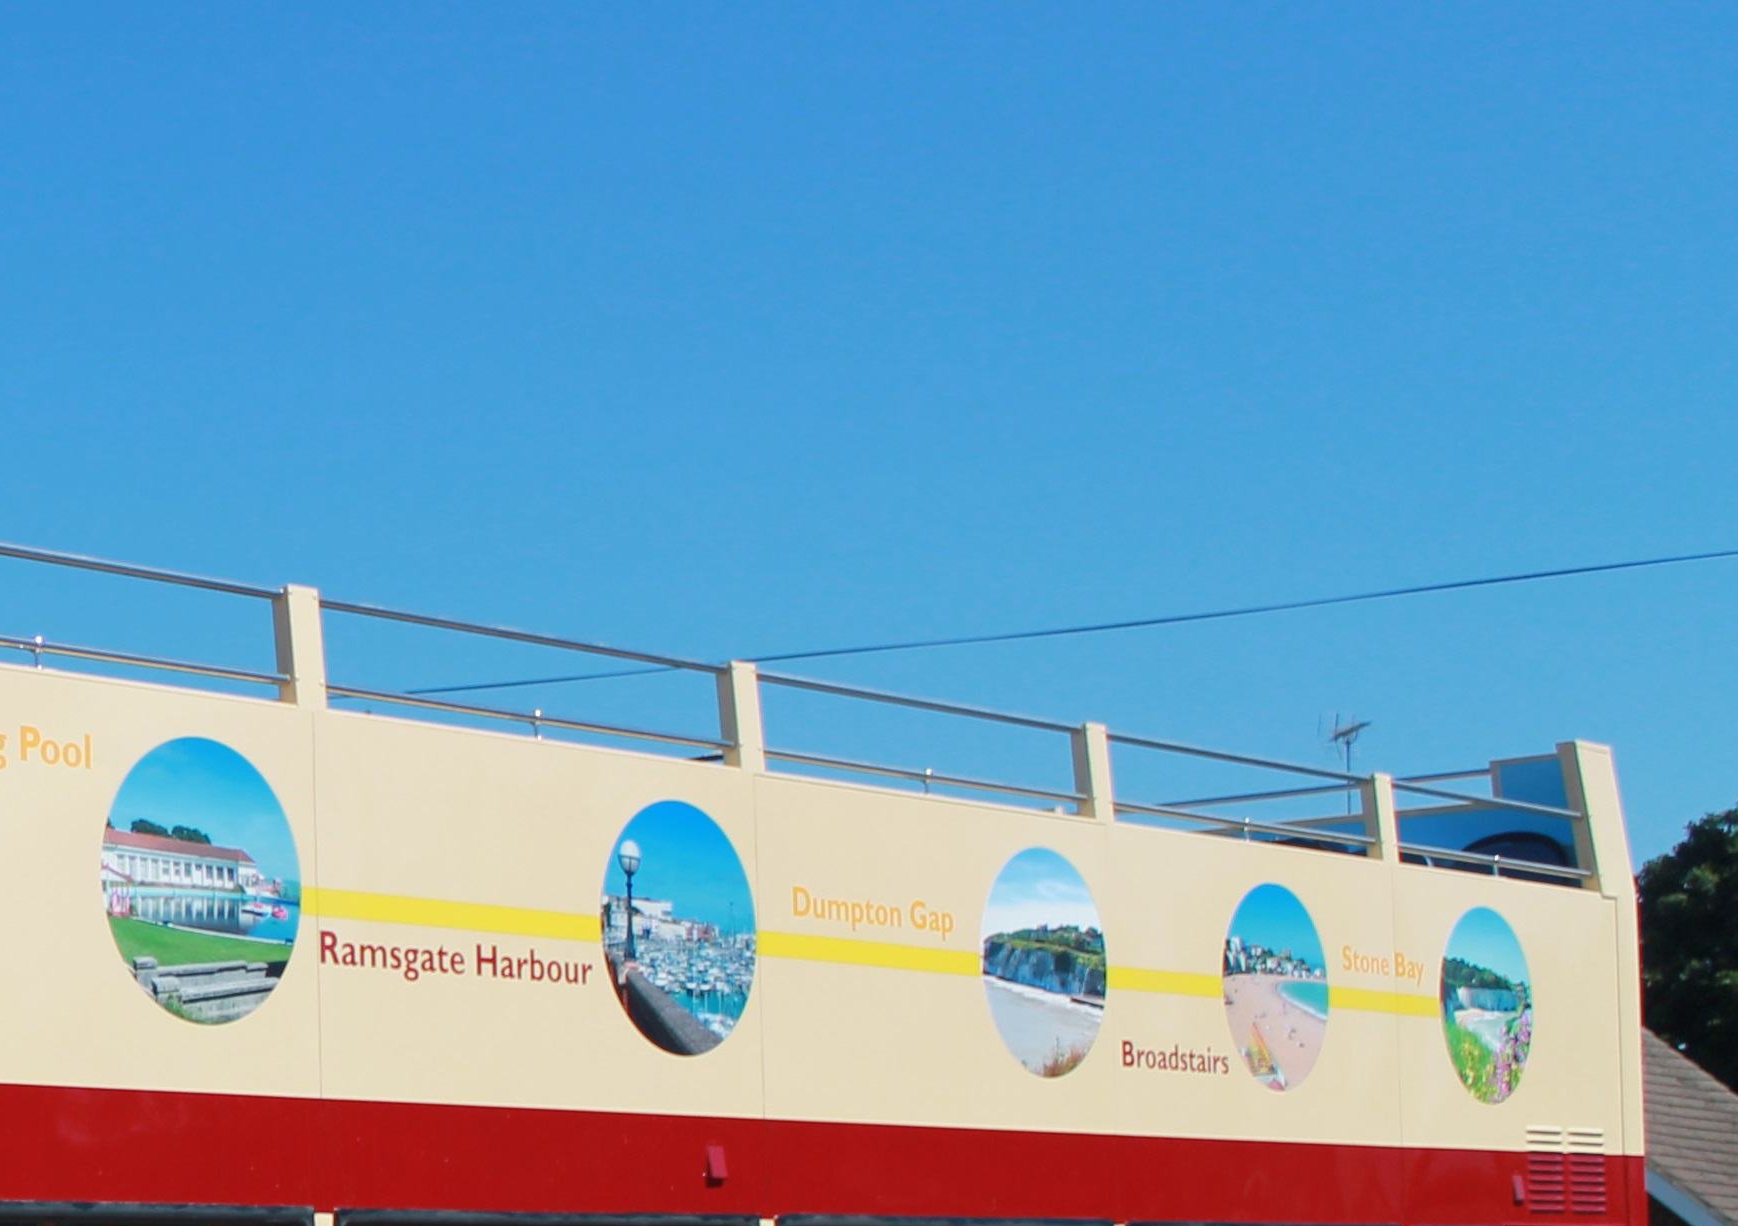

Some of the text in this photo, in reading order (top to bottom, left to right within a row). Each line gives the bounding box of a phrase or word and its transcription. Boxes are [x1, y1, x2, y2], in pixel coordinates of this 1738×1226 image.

[19, 725, 91, 769] Pool
[792, 885, 954, 941] Dumpton Gap
[319, 931, 593, 985] Ramsgate Harbour
[1342, 945, 1424, 986] Stone Bay
[1121, 1040, 1229, 1075] Broadstairs
